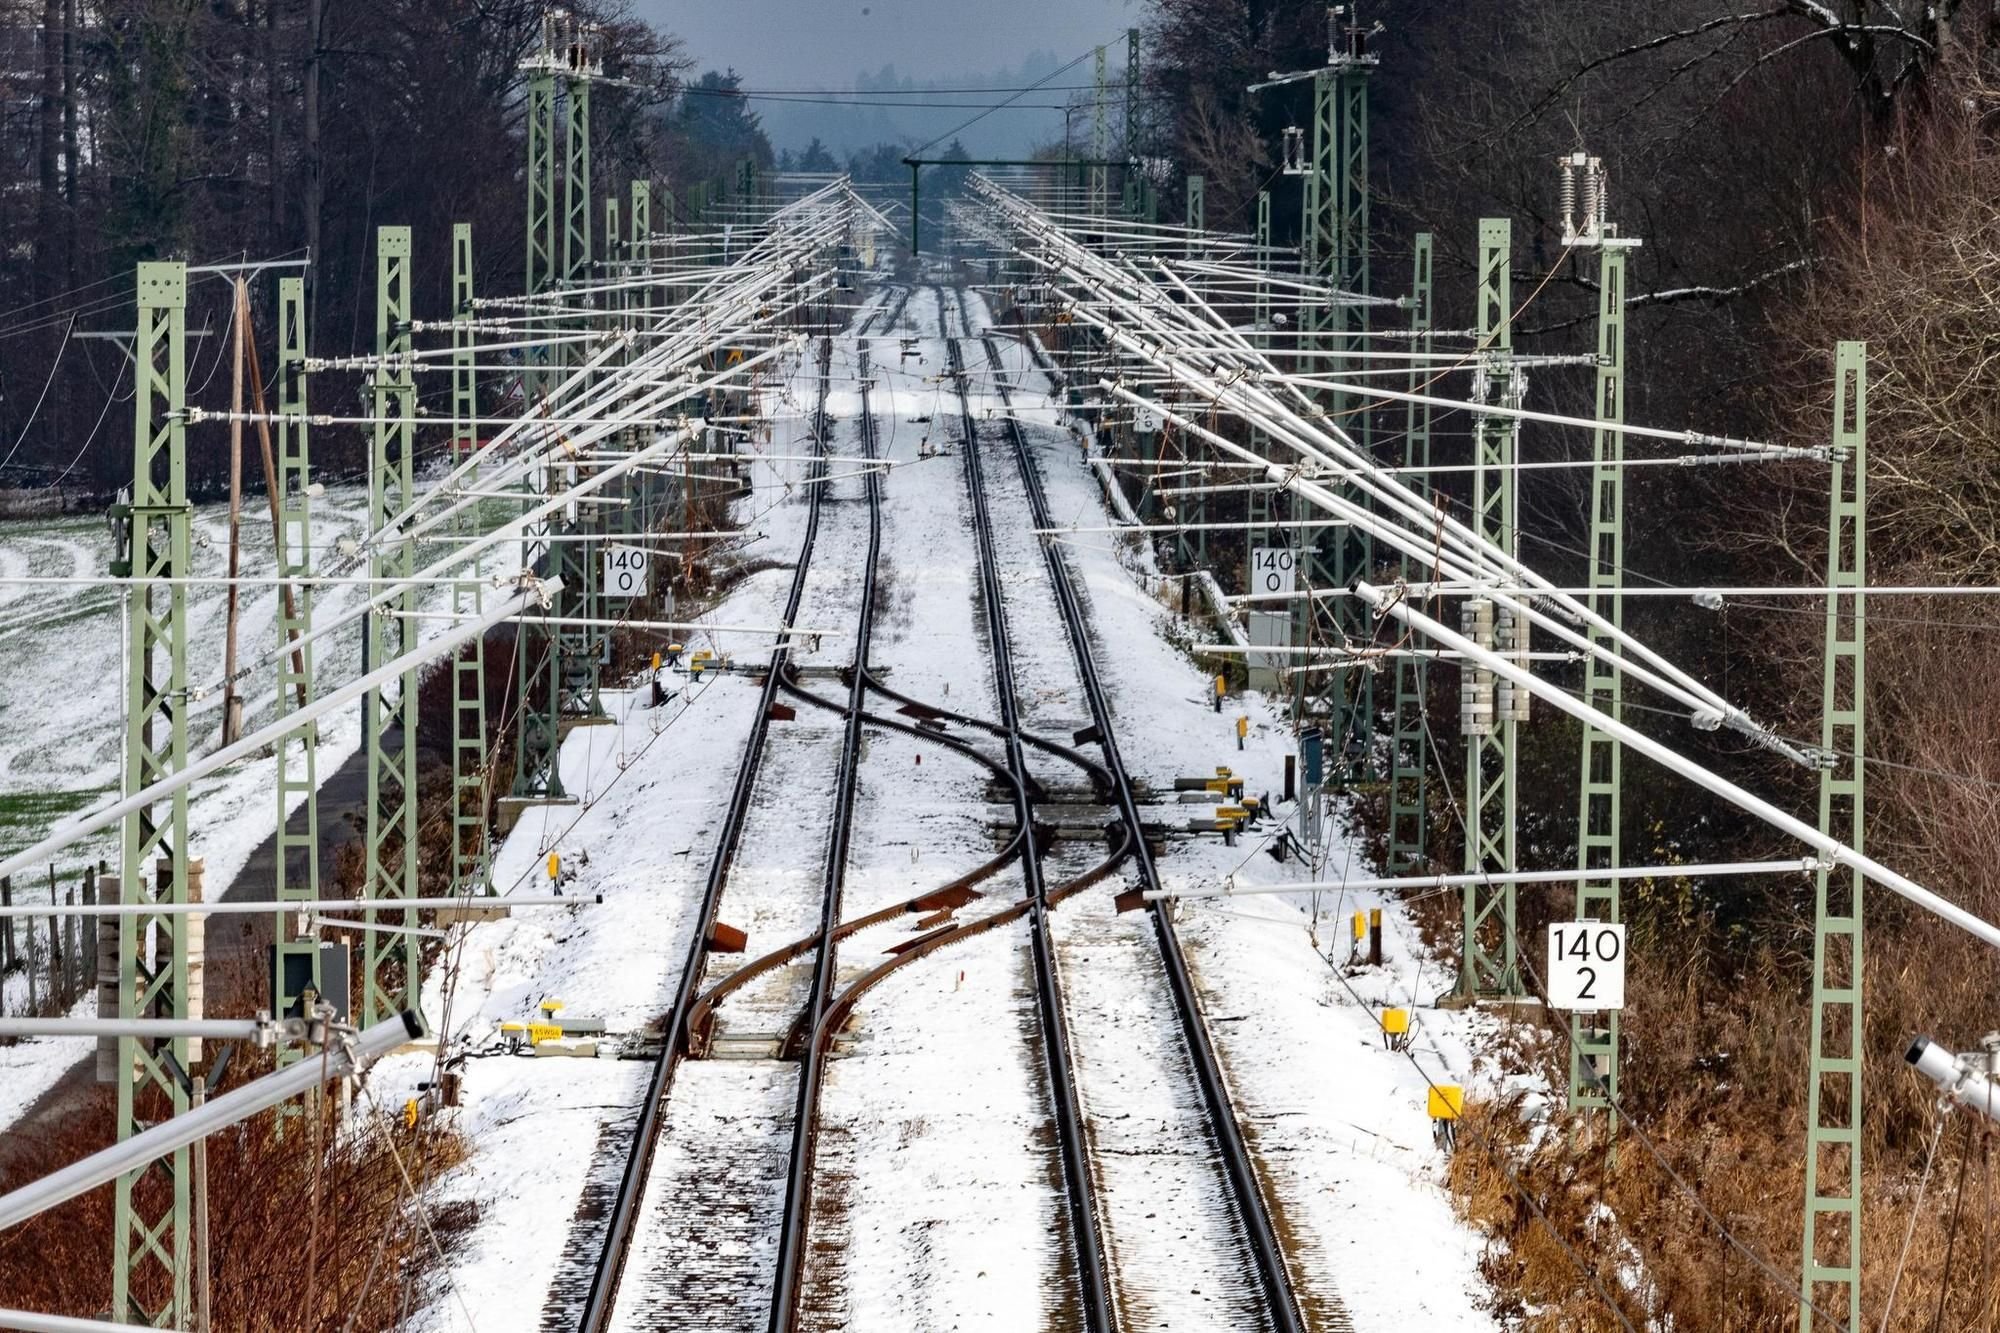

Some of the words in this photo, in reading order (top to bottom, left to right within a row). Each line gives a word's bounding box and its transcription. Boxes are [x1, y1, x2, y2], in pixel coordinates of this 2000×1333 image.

[606, 551, 645, 570] 140
[1254, 551, 1293, 571] 140
[618, 572, 633, 591] 0
[1266, 573, 1281, 592] 0
[1553, 928, 1620, 962] 140
[1576, 966, 1597, 999] 2
